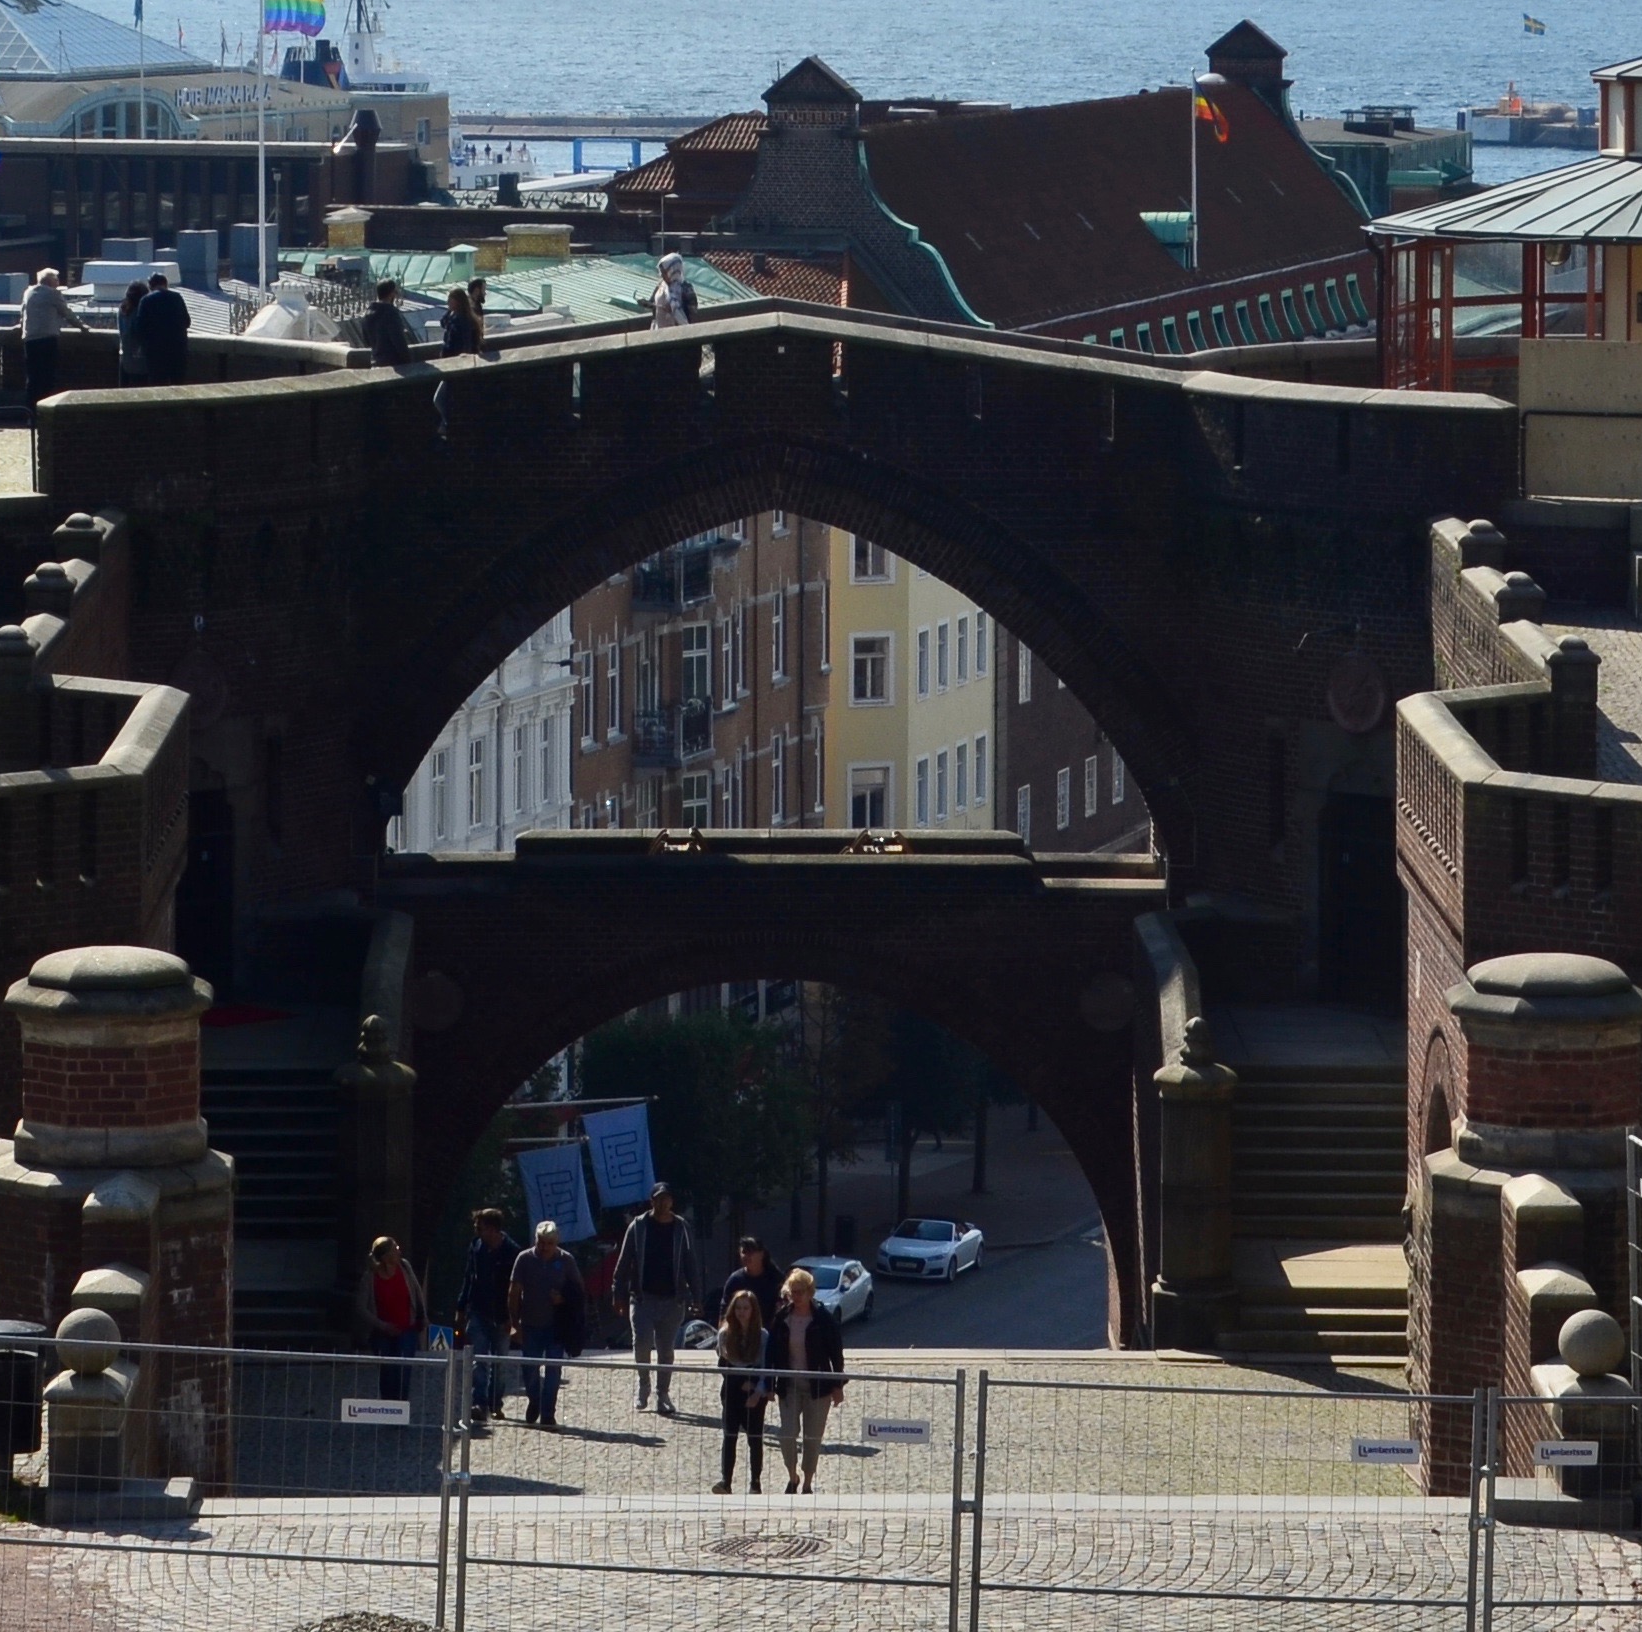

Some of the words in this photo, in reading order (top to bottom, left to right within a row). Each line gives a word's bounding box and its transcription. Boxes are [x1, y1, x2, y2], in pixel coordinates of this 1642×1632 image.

[348, 1405, 403, 1417] Lambertsson
[868, 1424, 923, 1436] Lambertsson
[1358, 1445, 1414, 1457] Lambertsson
[1540, 1448, 1593, 1459] Lambertsson
